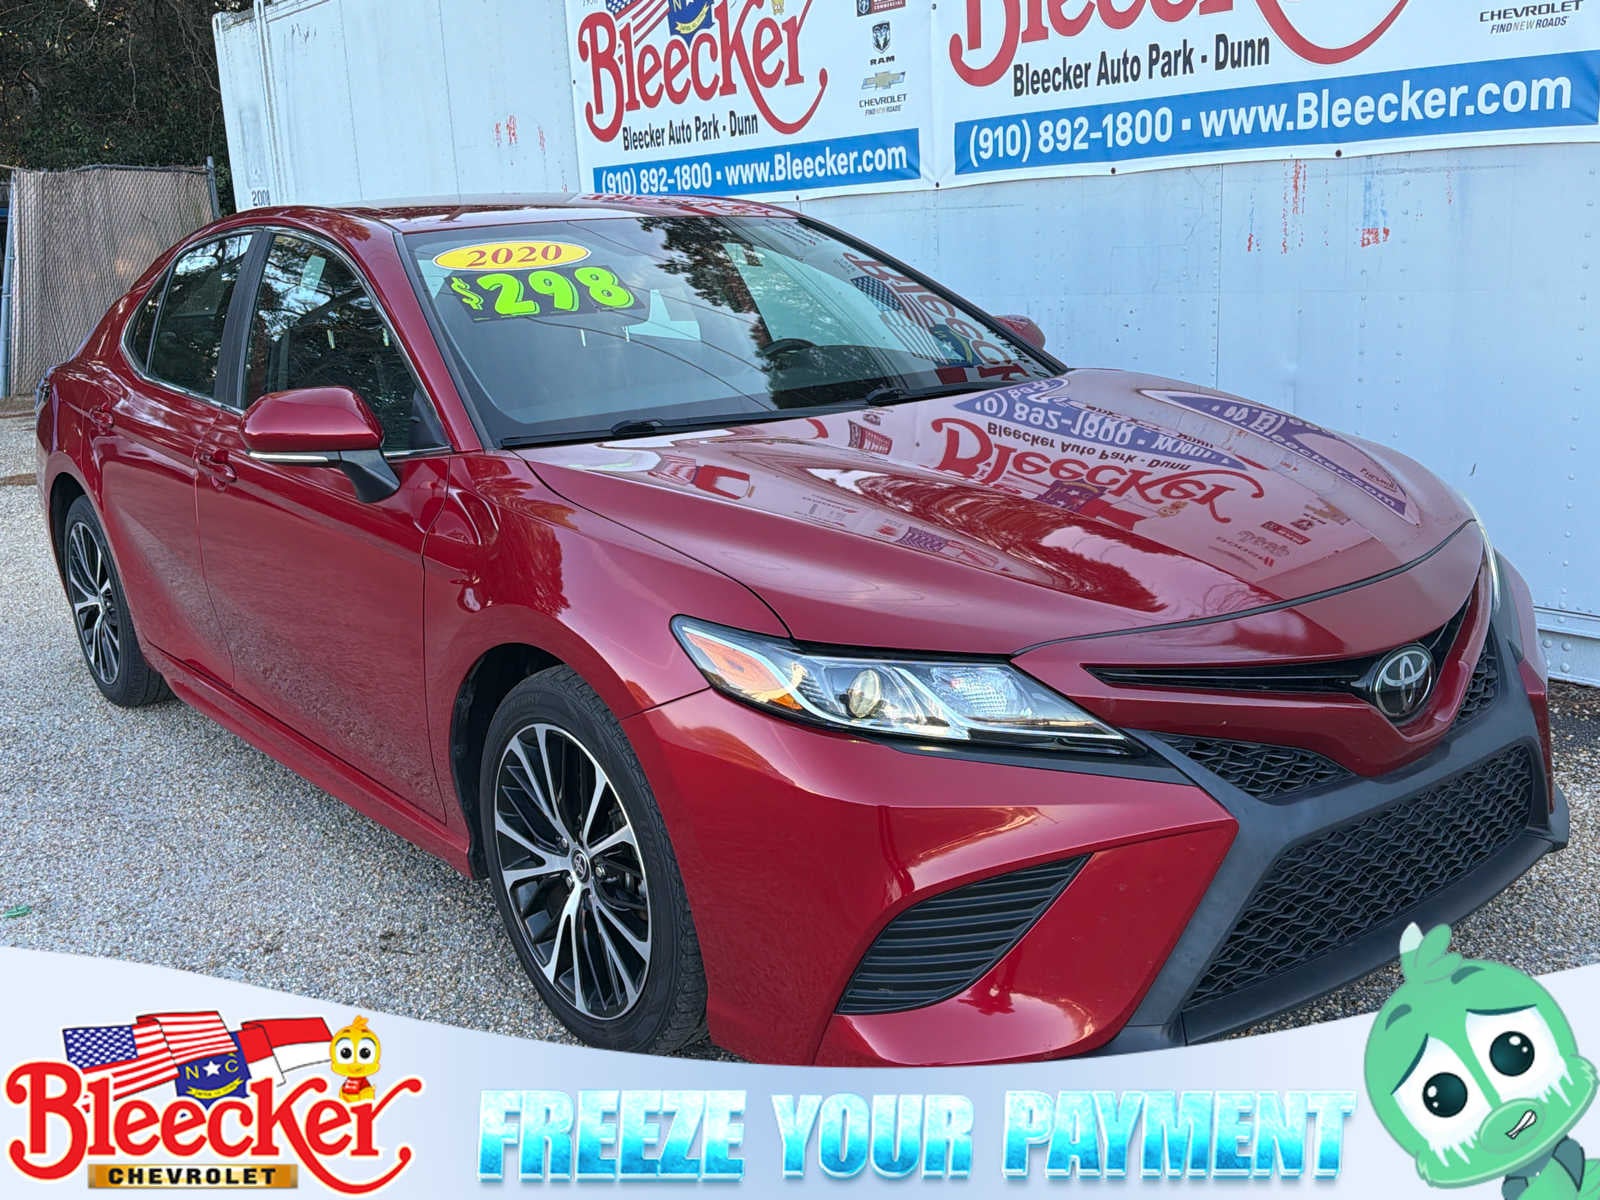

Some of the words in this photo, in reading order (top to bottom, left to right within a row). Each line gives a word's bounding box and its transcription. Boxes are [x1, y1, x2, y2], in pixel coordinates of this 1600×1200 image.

[1480, 0, 1584, 22] CHEVROLET
[578, 0, 828, 142] Bleecker
[870, 55, 895, 66] RAM
[1013, 57, 1091, 97] Bleecker
[1097, 49, 1141, 86] Auto
[1148, 39, 1195, 80] Park
[1214, 33, 1270, 71] Dunn
[859, 93, 907, 108] CHEVROLET
[969, 119, 1031, 168] (910)
[1038, 107, 1172, 154] 892-1800
[1200, 75, 1572, 139] www.Bleecker.com
[622, 123, 665, 151] Bleecker
[668, 119, 692, 145] Auto
[694, 114, 720, 142] Park
[729, 110, 759, 137] Dunn
[601, 168, 637, 194] (910)
[639, 162, 712, 194] 892-1800
[725, 145, 908, 186] www.Bleecker.com
[467, 244, 563, 267] 2020
[451, 266, 635, 316] $298
